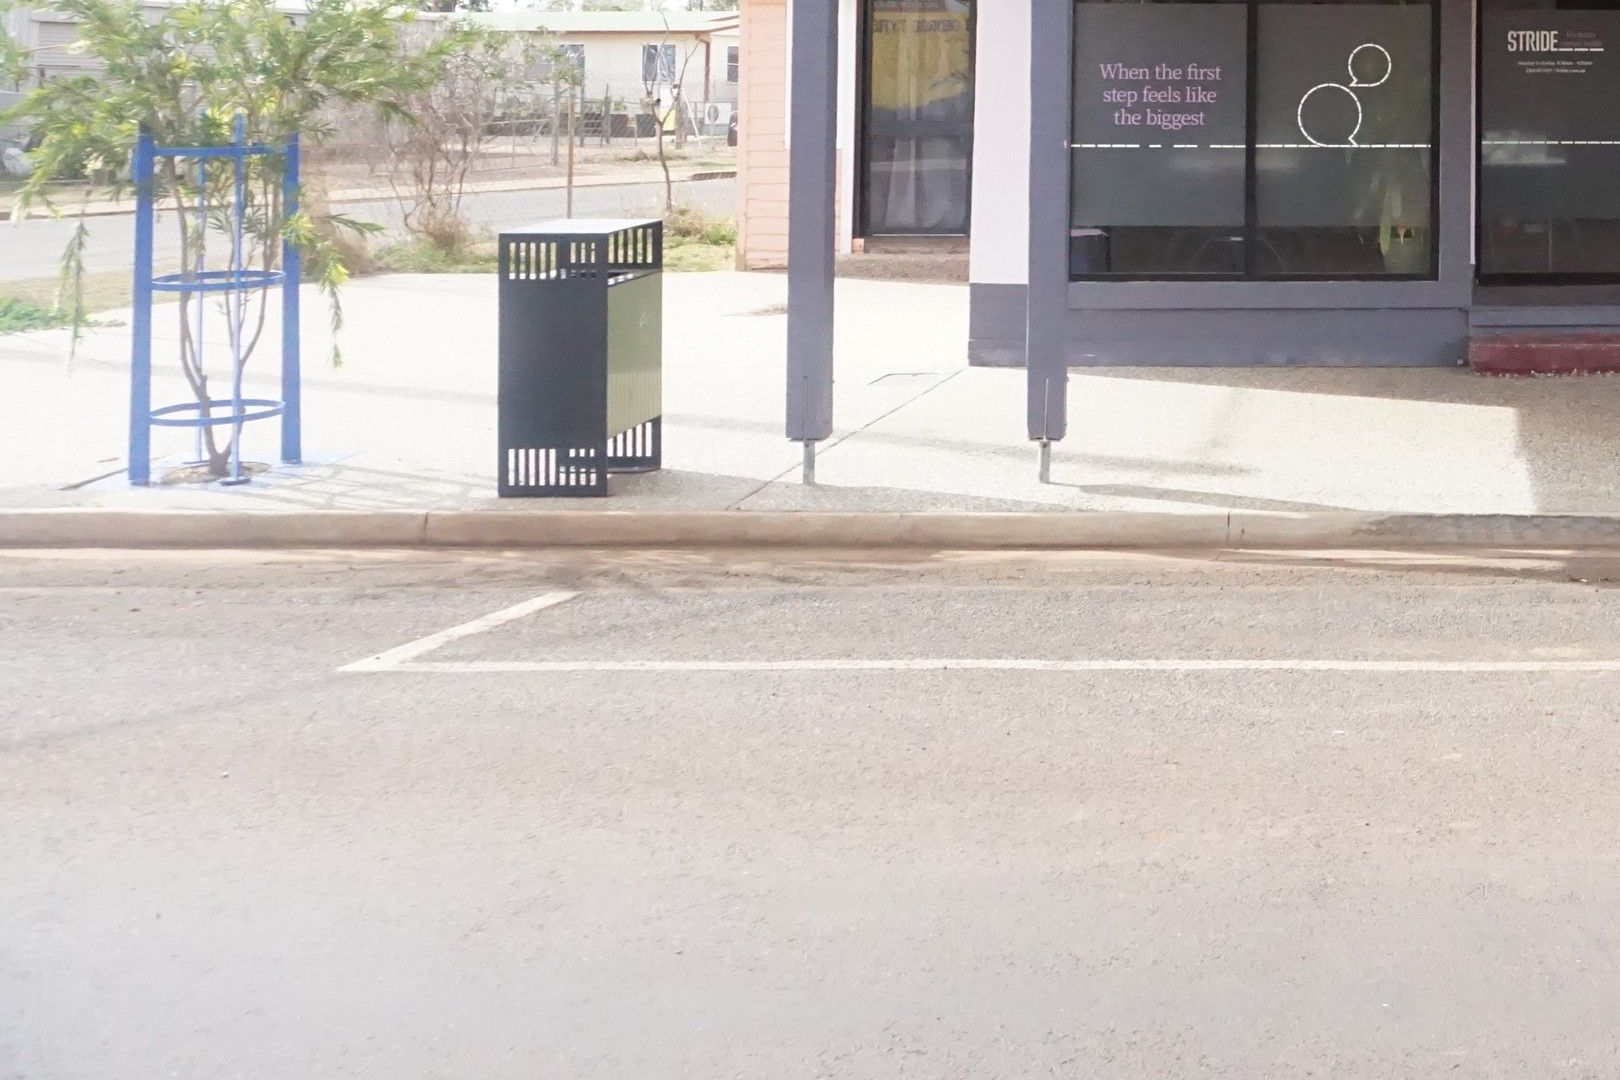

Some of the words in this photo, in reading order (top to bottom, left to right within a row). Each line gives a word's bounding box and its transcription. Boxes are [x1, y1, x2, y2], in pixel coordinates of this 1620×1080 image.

[1507, 30, 1558, 52] STRIDE
[1100, 63, 1150, 80] When
[1155, 63, 1182, 80] the
[1187, 63, 1222, 80] first
[1103, 88, 1138, 107] step
[1142, 86, 1181, 103] feels
[1186, 86, 1217, 103] like
[1113, 108, 1142, 126] the
[1146, 108, 1206, 130] biggest
